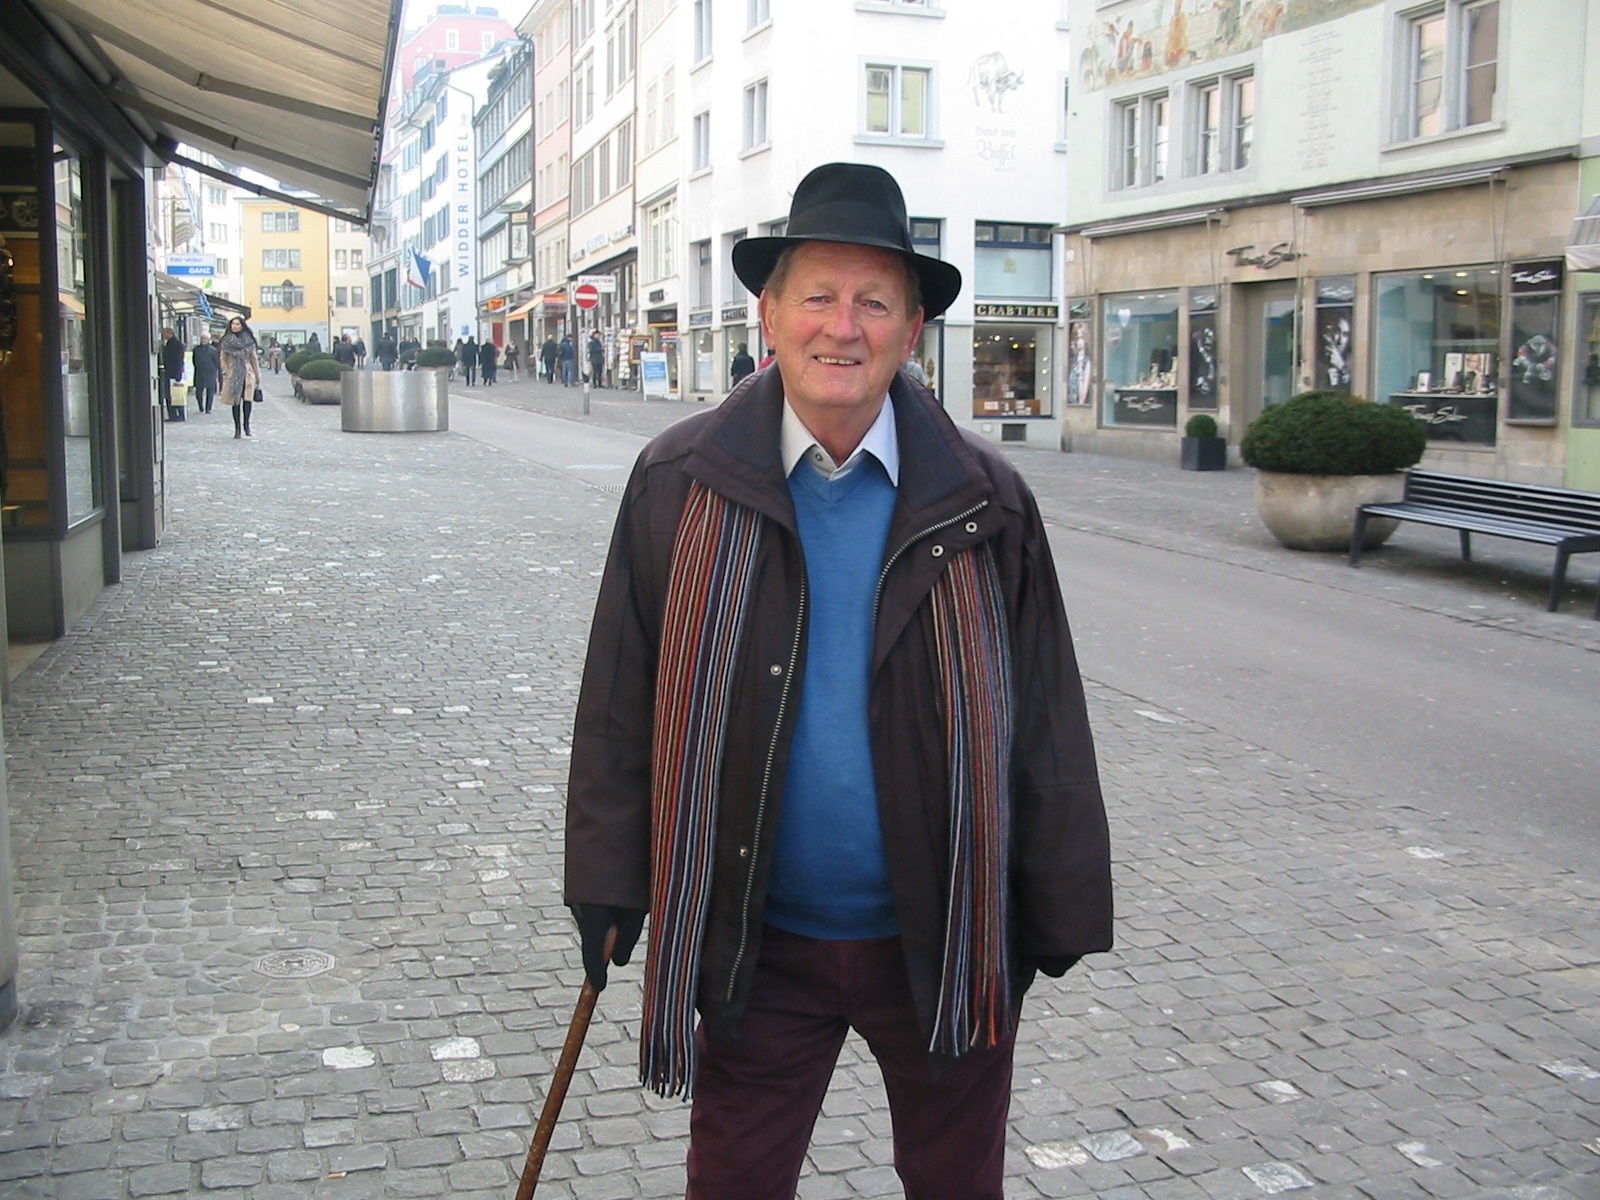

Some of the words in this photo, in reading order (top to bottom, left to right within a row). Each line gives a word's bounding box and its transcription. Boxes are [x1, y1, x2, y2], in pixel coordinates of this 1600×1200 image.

[457, 133, 468, 192] HOTEL
[457, 203, 469, 278] WIDDER
[188, 267, 211, 275] GANZ
[977, 305, 1055, 317] CRABTREE
